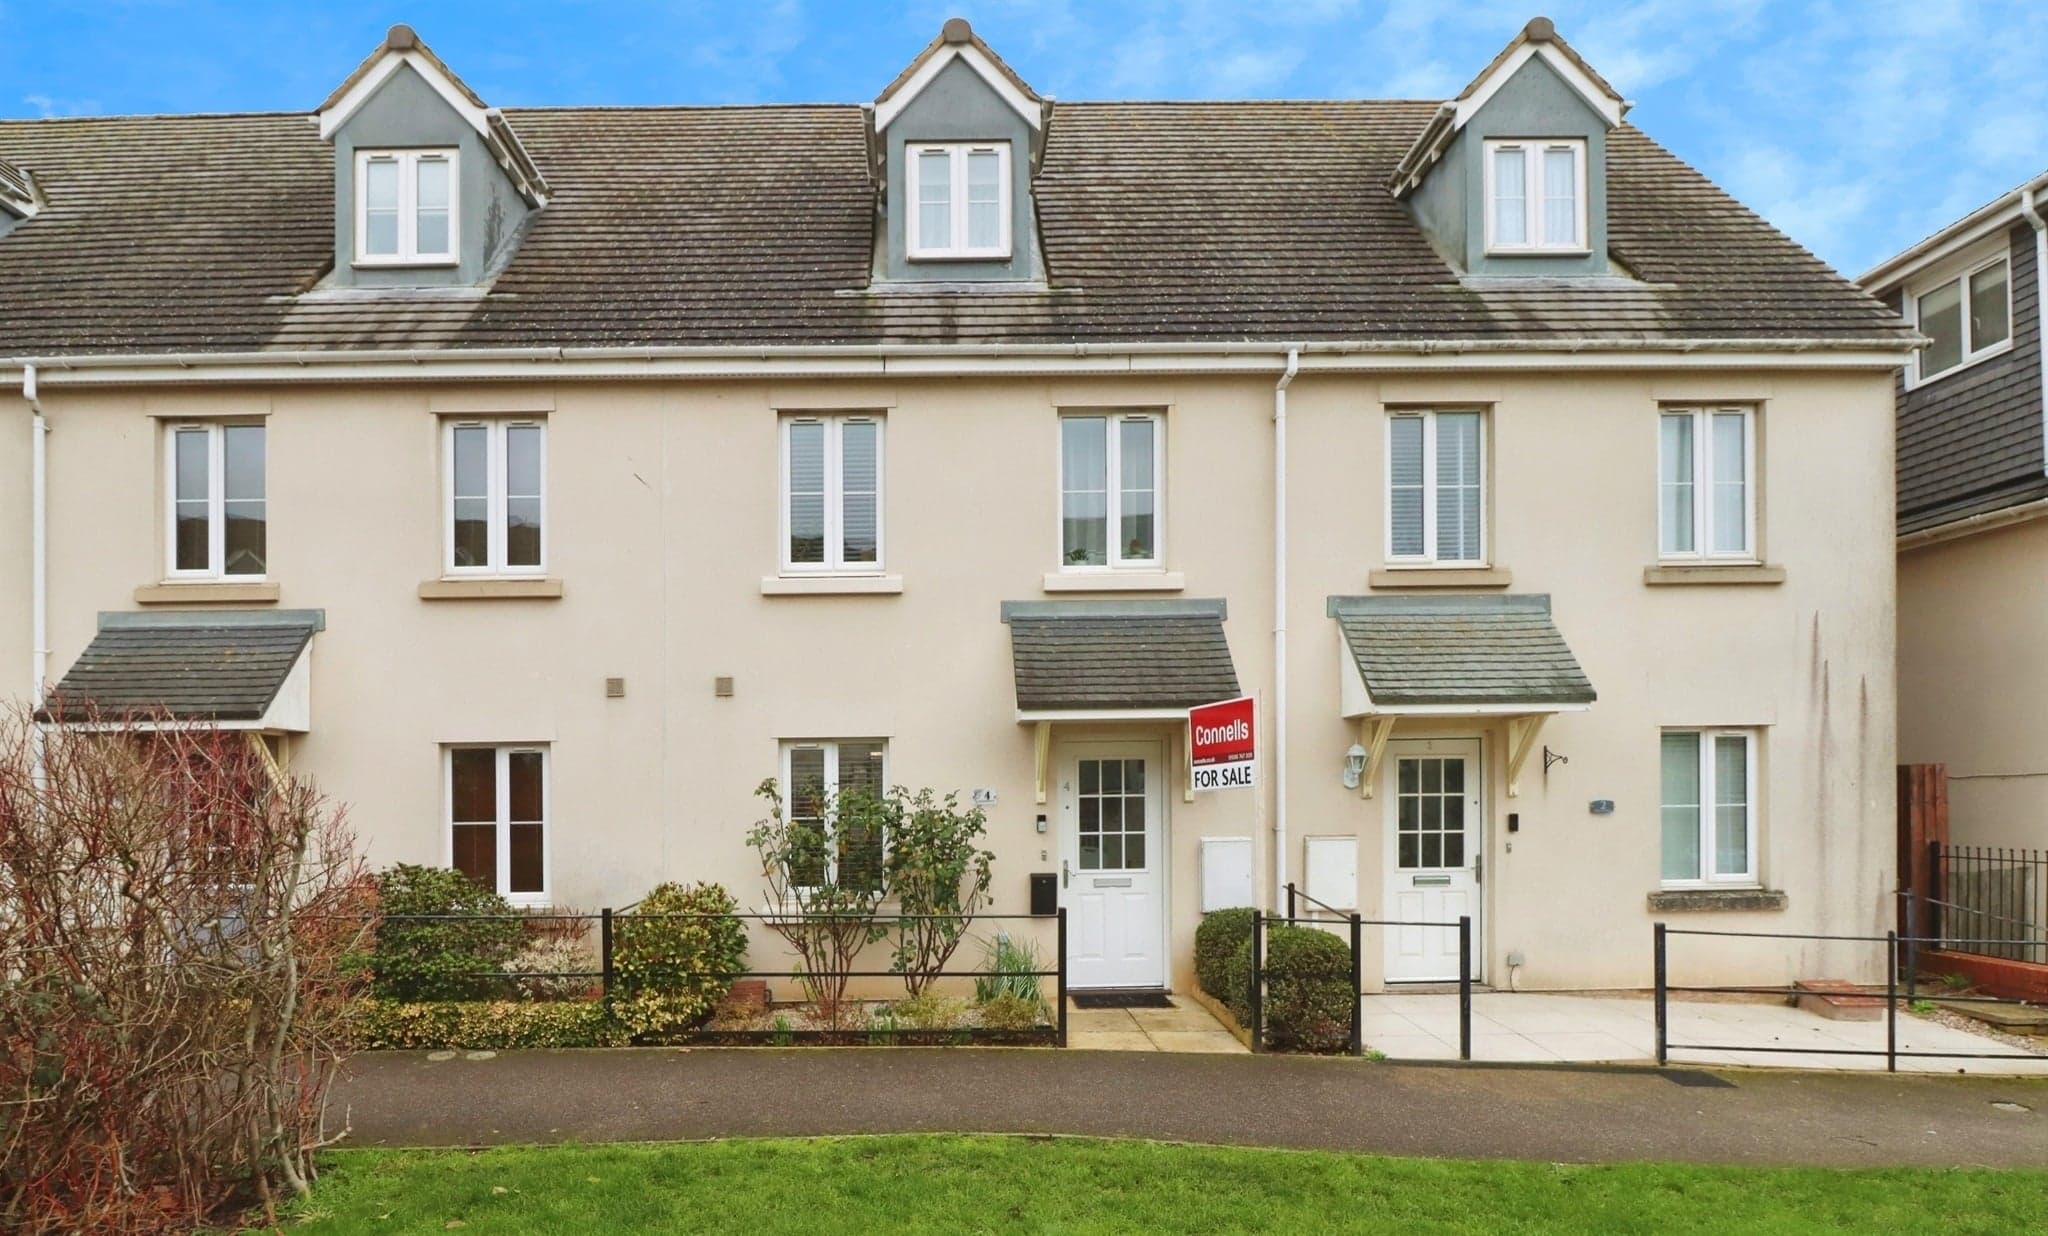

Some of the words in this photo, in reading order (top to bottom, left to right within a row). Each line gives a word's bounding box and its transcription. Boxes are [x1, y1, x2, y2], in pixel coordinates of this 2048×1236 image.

[1195, 718, 1249, 746] Connells
[1194, 769, 1219, 788] FOR
[1222, 766, 1251, 786] SALE
